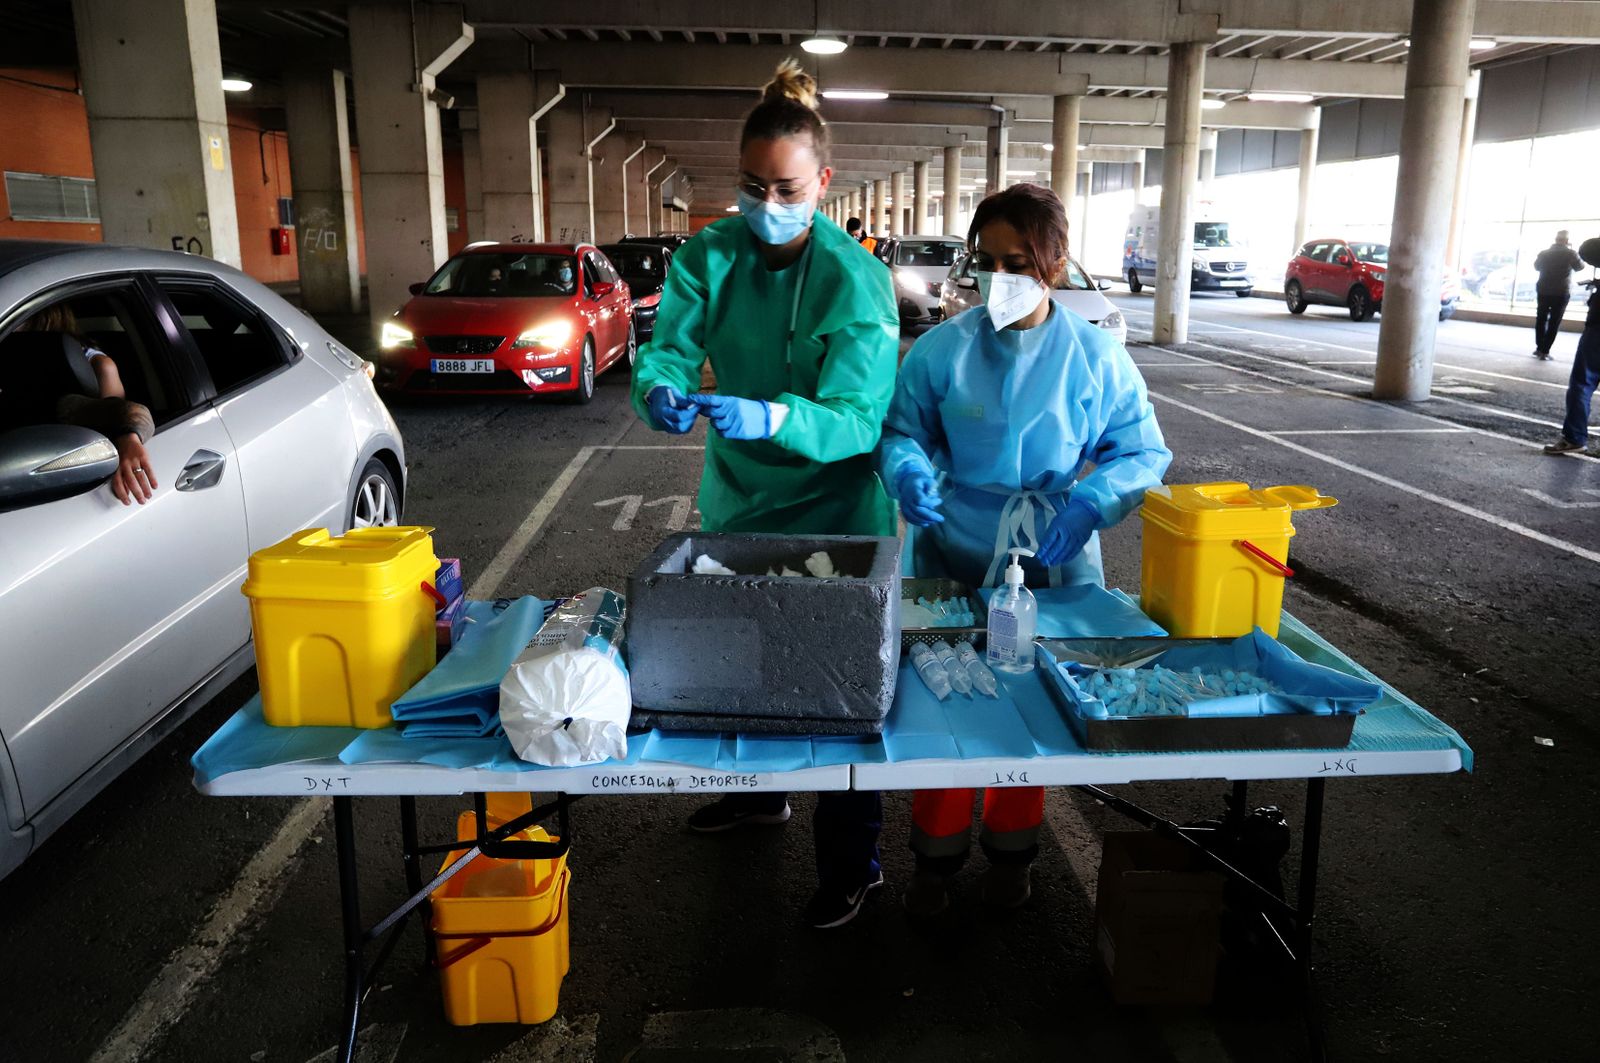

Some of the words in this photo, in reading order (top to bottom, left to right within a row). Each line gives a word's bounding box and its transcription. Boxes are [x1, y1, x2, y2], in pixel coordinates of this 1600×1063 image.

[438, 361, 467, 372] 8888
[471, 361, 492, 372] JFL
[593, 494, 702, 531] 11
[1317, 759, 1357, 773] DXT
[303, 777, 351, 791] DXT
[689, 774, 758, 788] DEPORTES
[990, 770, 1029, 785] DXT
